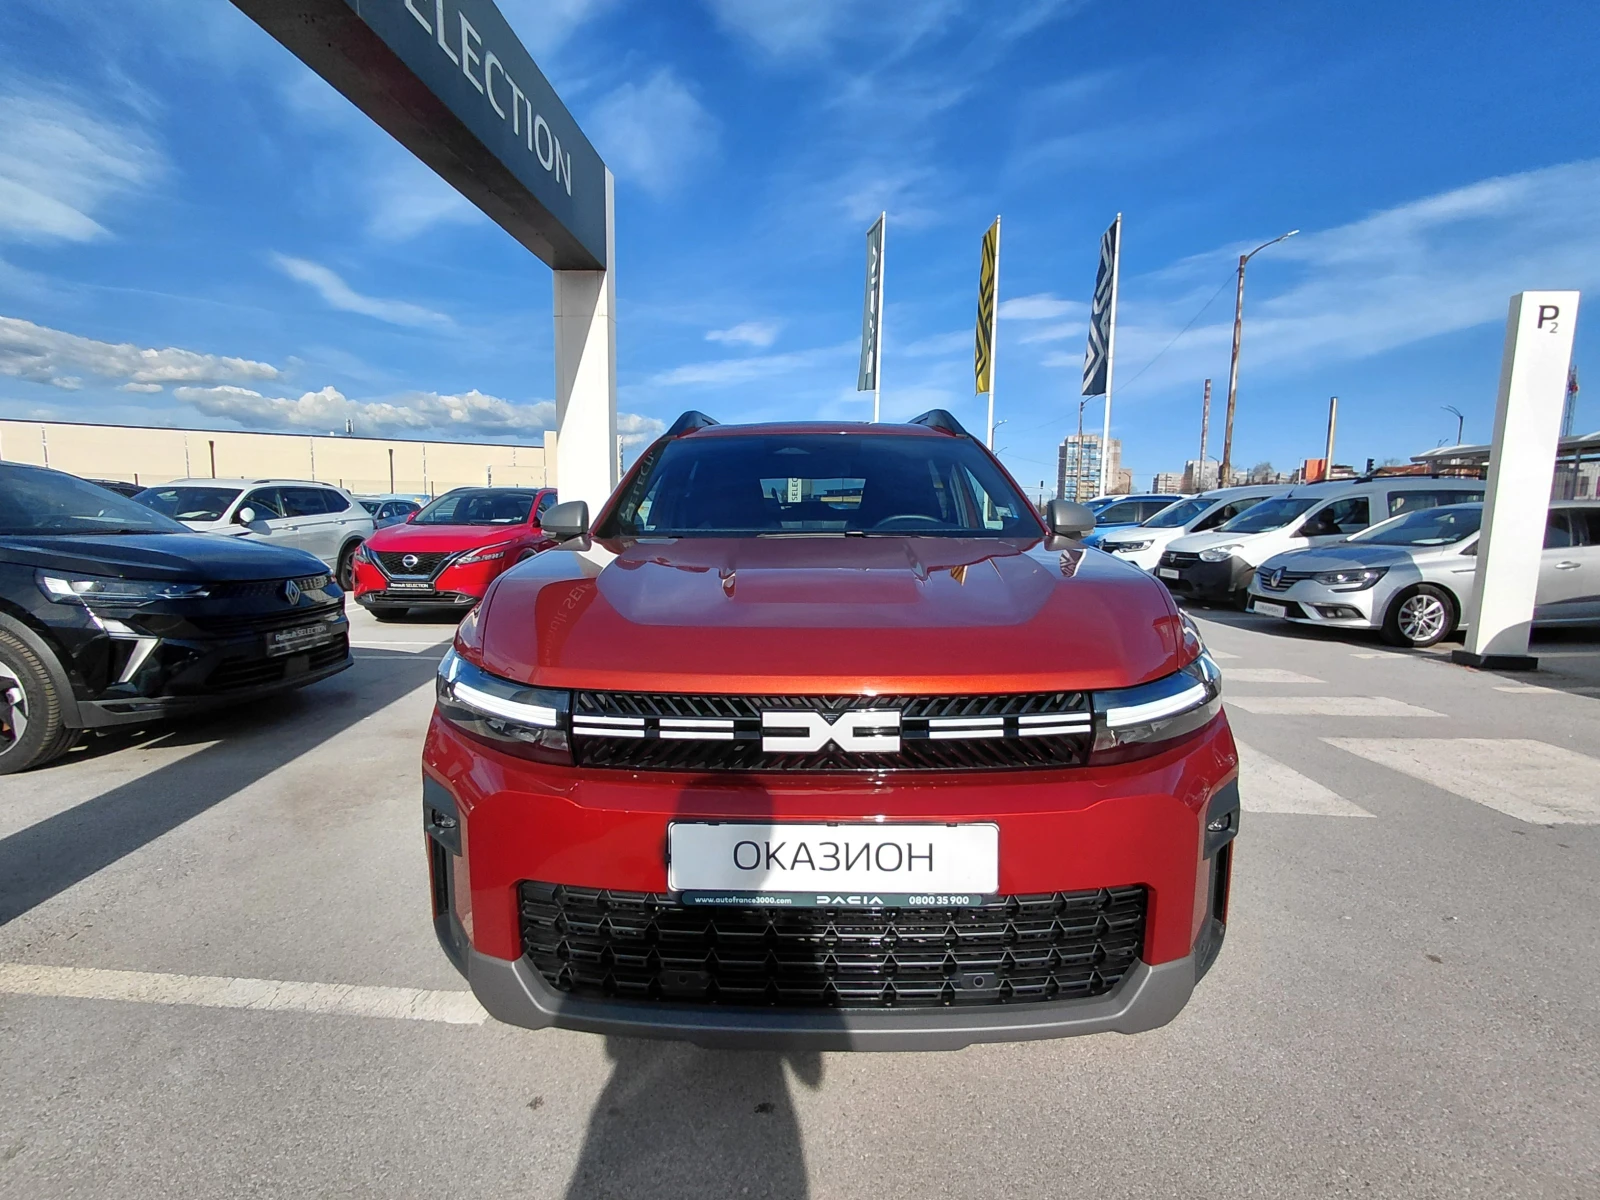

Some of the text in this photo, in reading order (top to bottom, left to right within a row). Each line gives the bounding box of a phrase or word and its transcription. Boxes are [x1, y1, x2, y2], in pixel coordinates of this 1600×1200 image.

[733, 841, 934, 872] ОКАЗИОН
[694, 895, 970, 905] www.autofrance3000.com DACIA 0800 35 900
